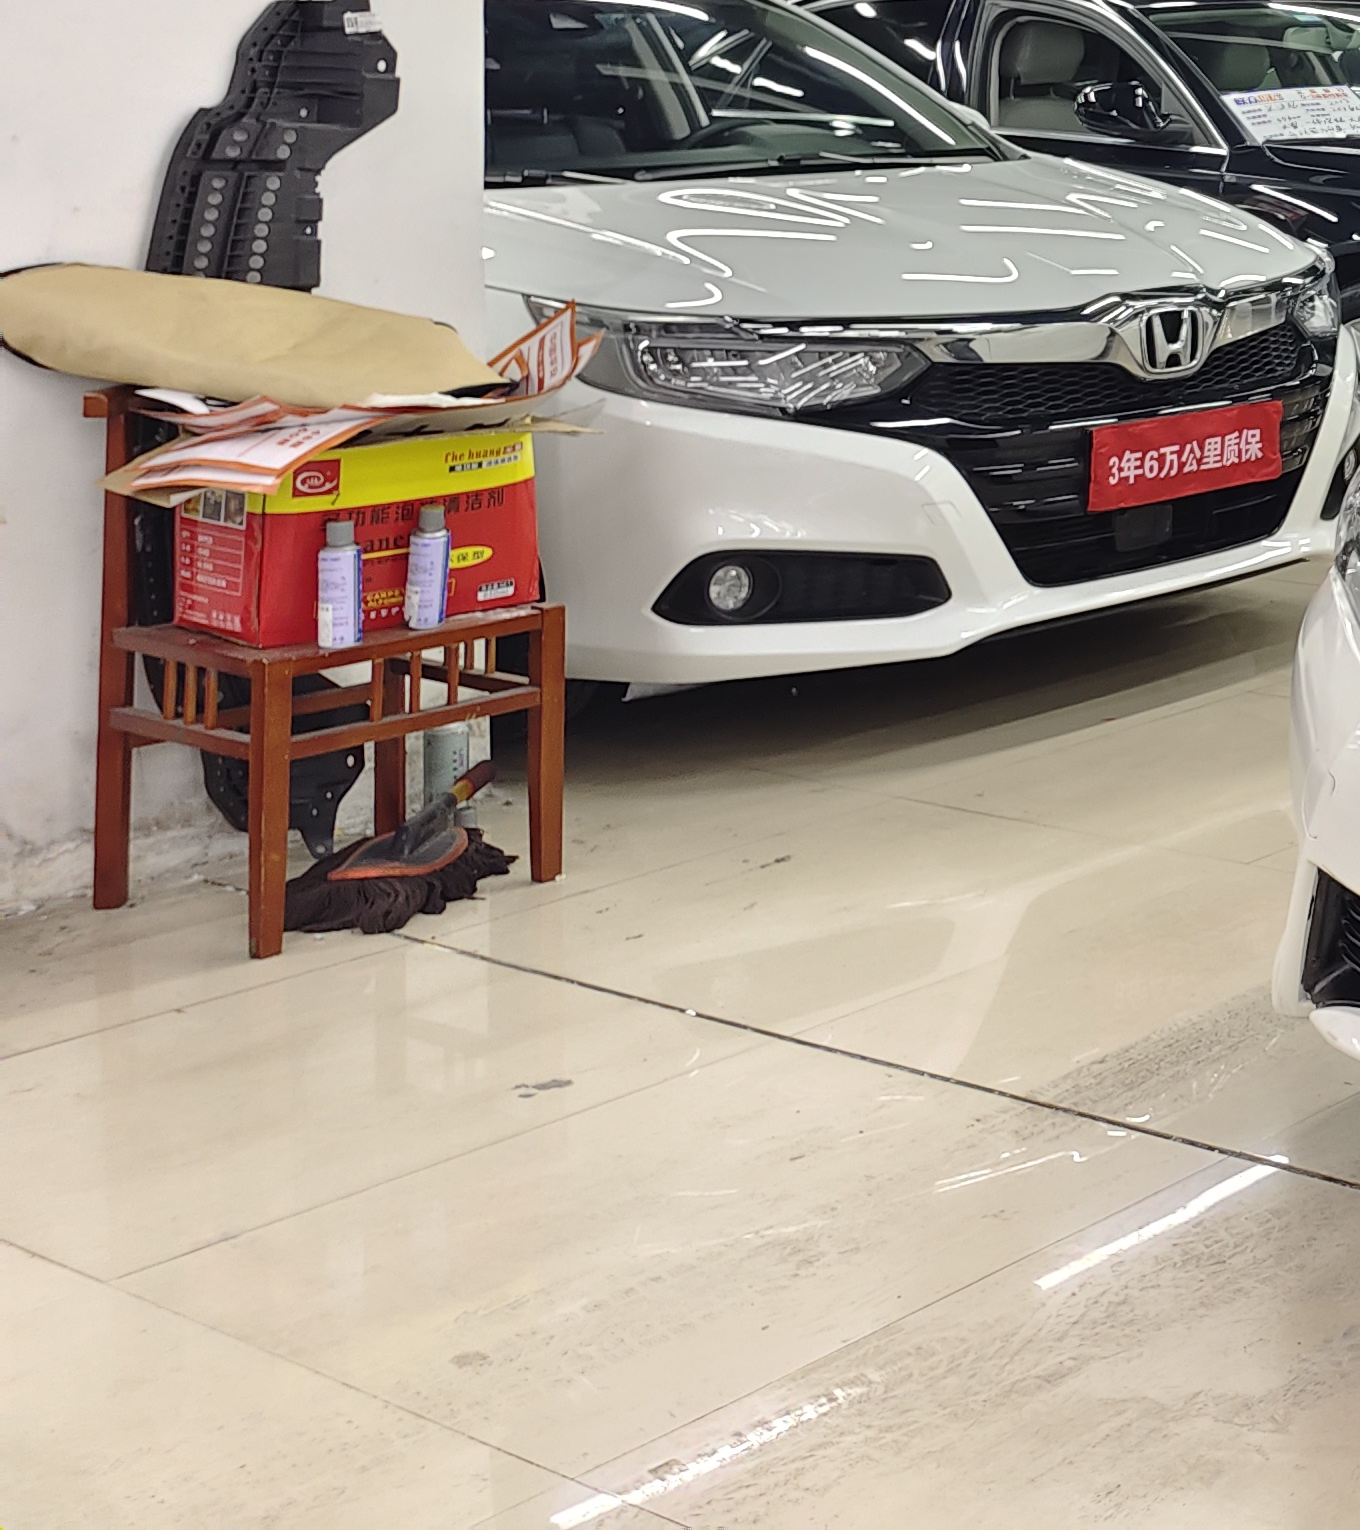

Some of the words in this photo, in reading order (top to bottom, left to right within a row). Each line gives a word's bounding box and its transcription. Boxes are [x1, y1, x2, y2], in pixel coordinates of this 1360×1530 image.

[1108, 428, 1264, 485] 3年6万公里质保
[320, 487, 504, 531] 多功能泡清洁剂
[450, 549, 486, 563] 保型
